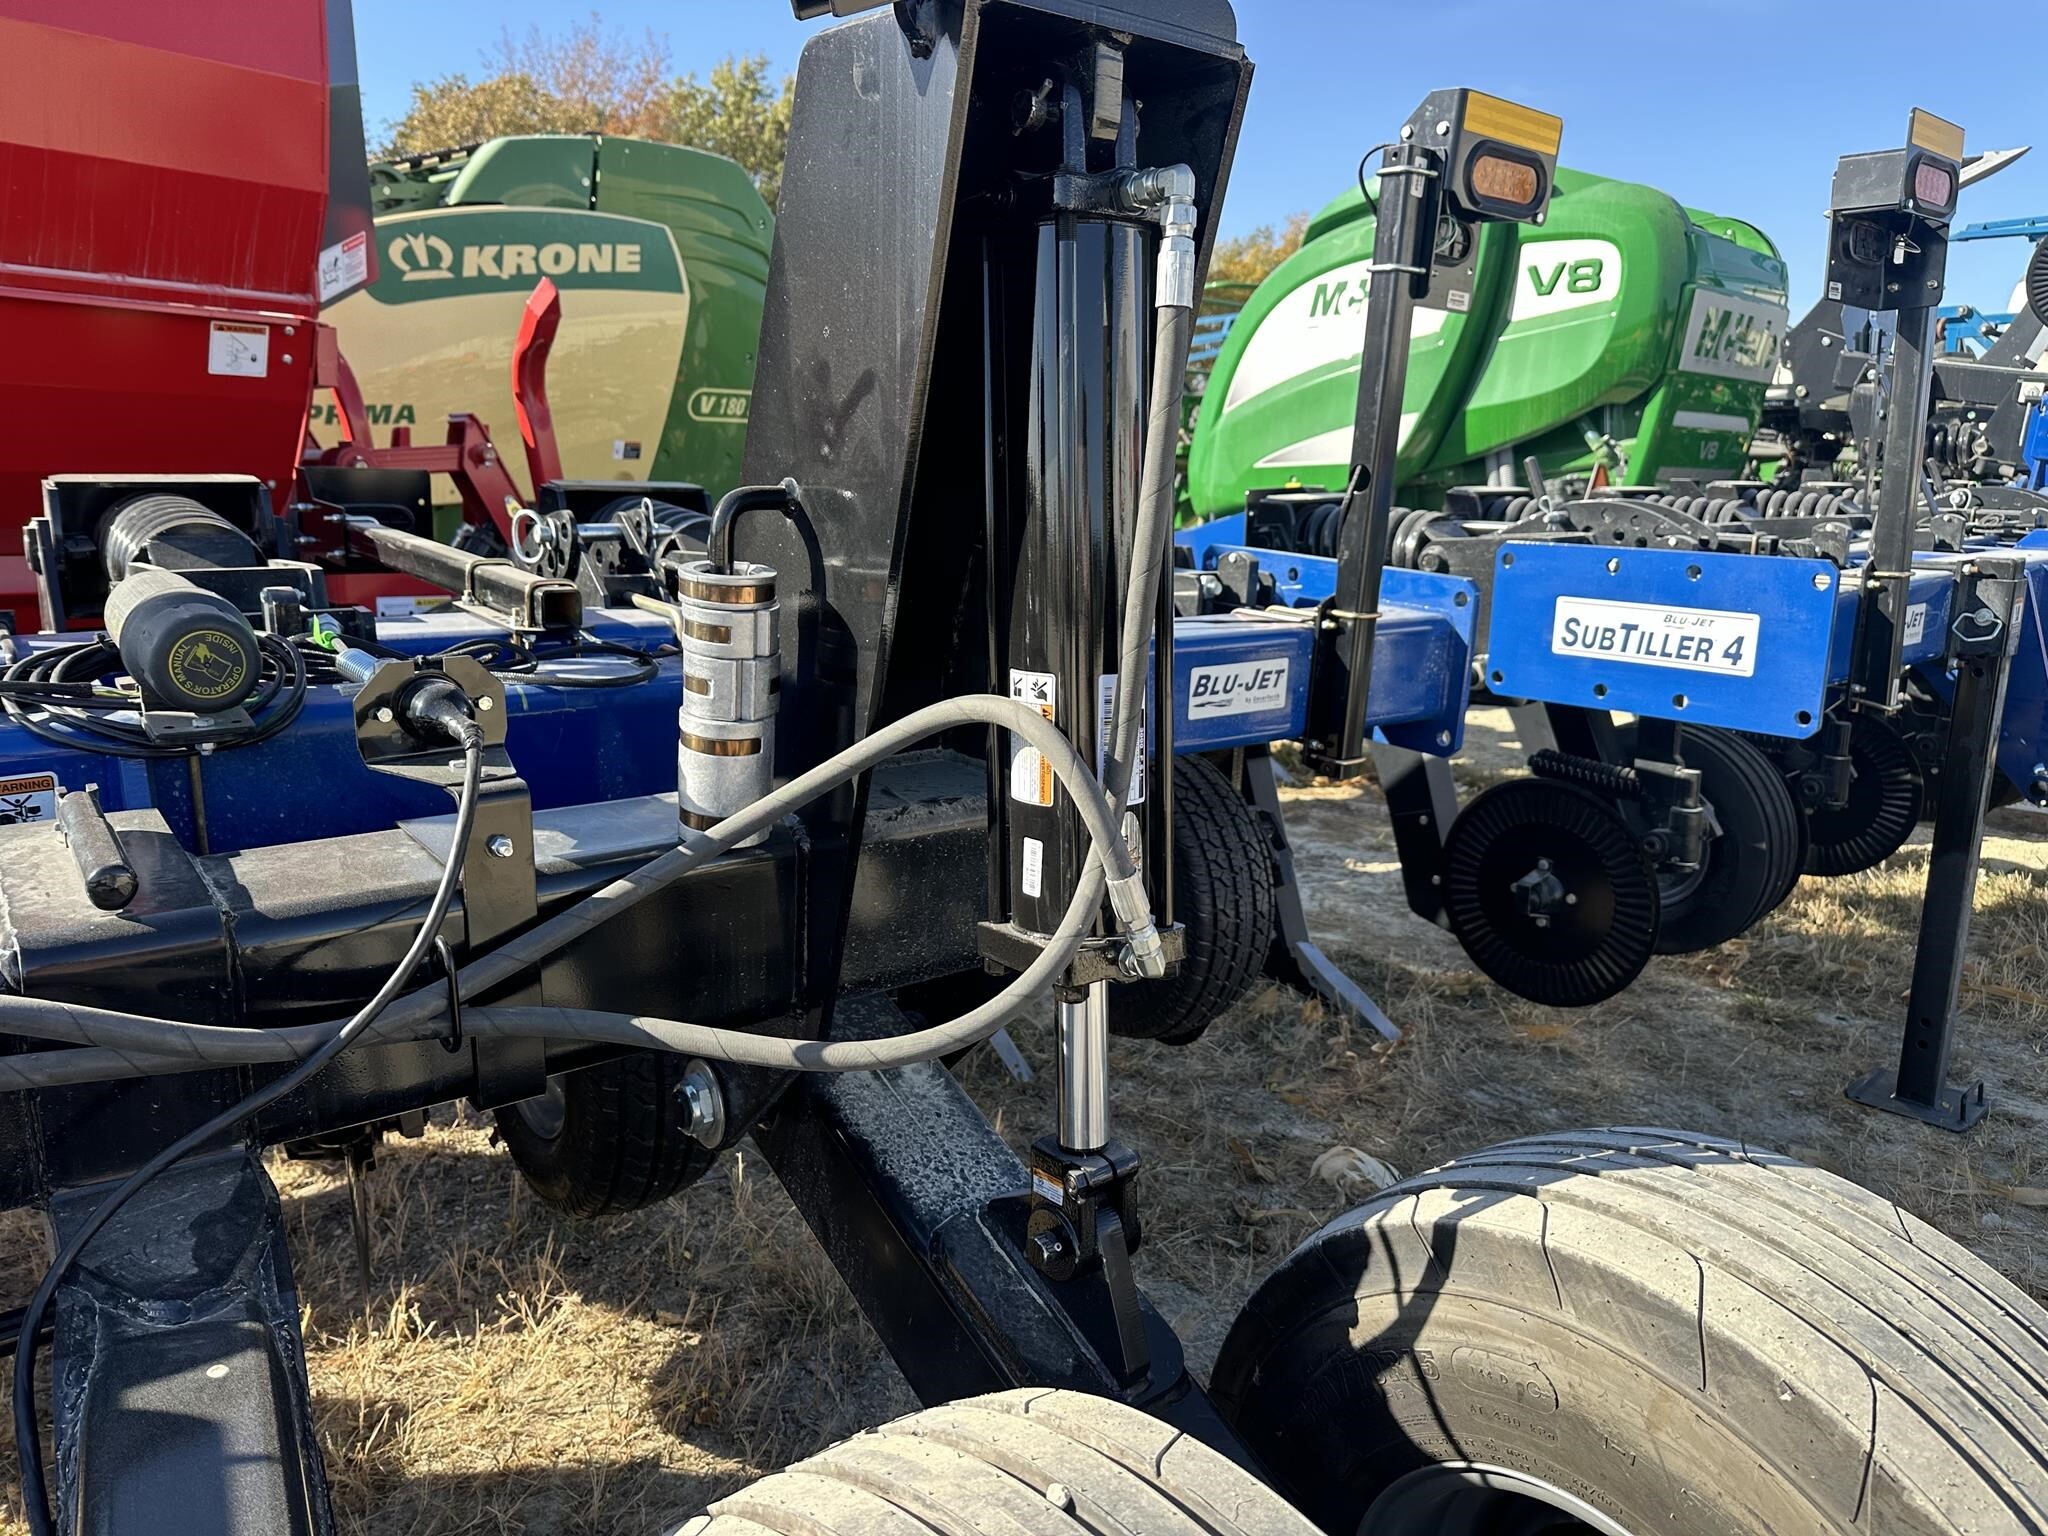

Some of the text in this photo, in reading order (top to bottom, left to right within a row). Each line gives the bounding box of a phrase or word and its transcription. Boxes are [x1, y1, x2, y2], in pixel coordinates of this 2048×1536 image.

[462, 243, 641, 279] KRONE
[1527, 258, 1603, 296] V8
[310, 405, 416, 425] PRMA
[701, 395, 747, 416] V 180
[1701, 441, 1719, 460] V8
[1664, 614, 1715, 627] BLU-JET
[1722, 635, 1745, 666] 4
[173, 634, 241, 695] OPERATOR'S MANUAL INSIDE
[1192, 668, 1285, 697] BLU-JET
[0, 779, 51, 792] ARNING
